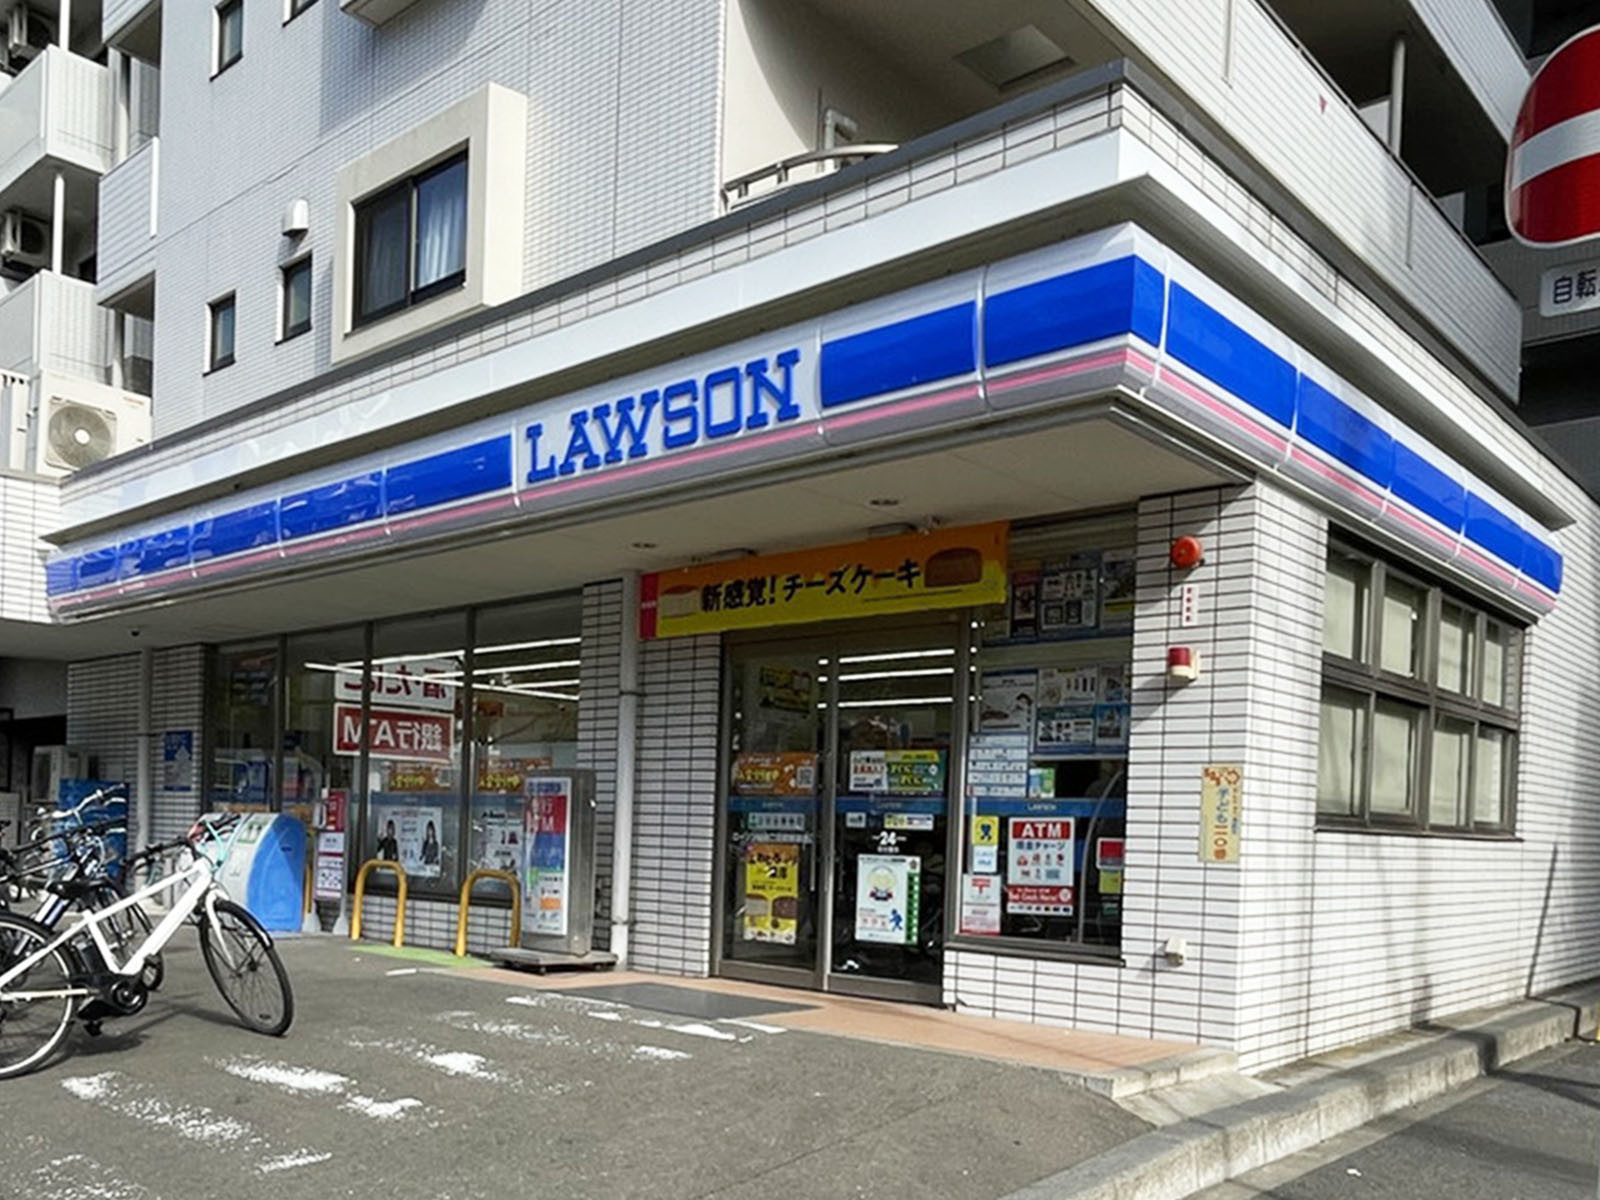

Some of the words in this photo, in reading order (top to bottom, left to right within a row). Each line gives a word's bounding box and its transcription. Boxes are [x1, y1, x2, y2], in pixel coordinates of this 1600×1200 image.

[1553, 268, 1600, 305] 自転
[526, 347, 801, 484] LAWSON
[879, 830, 897, 846] 24
[1021, 823, 1062, 838] ATM
